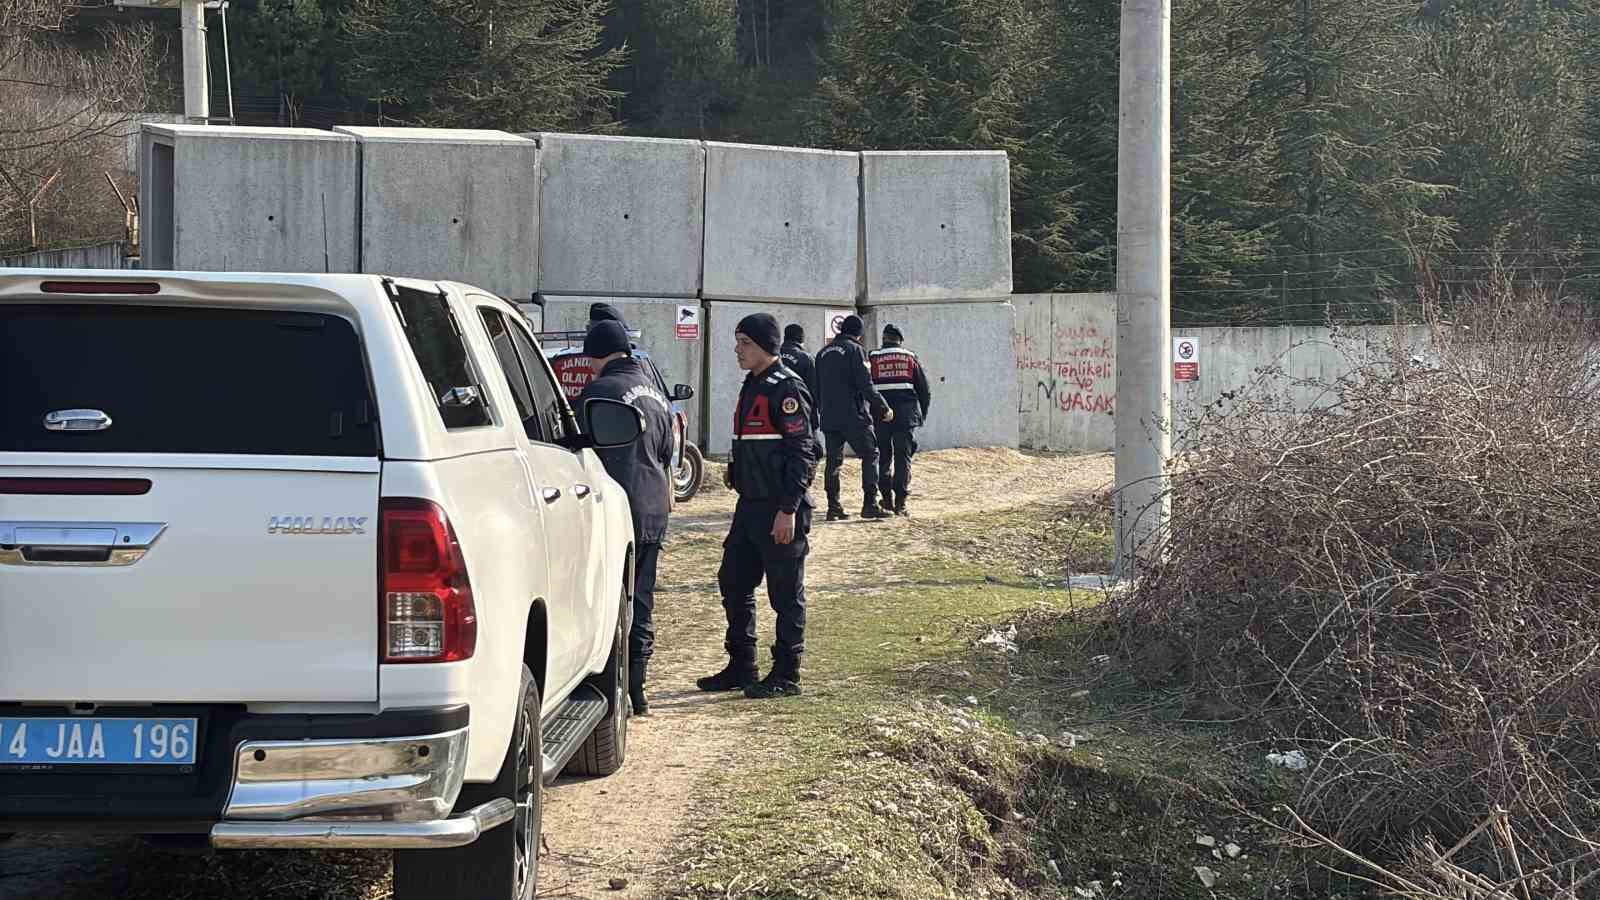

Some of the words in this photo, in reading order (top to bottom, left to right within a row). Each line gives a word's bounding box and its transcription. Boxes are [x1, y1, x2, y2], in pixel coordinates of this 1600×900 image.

[562, 372, 587, 384] OLAY
[267, 514, 368, 535] HILUX
[0, 722, 28, 759] 4
[45, 722, 105, 759] JAA
[132, 722, 189, 759] 196
